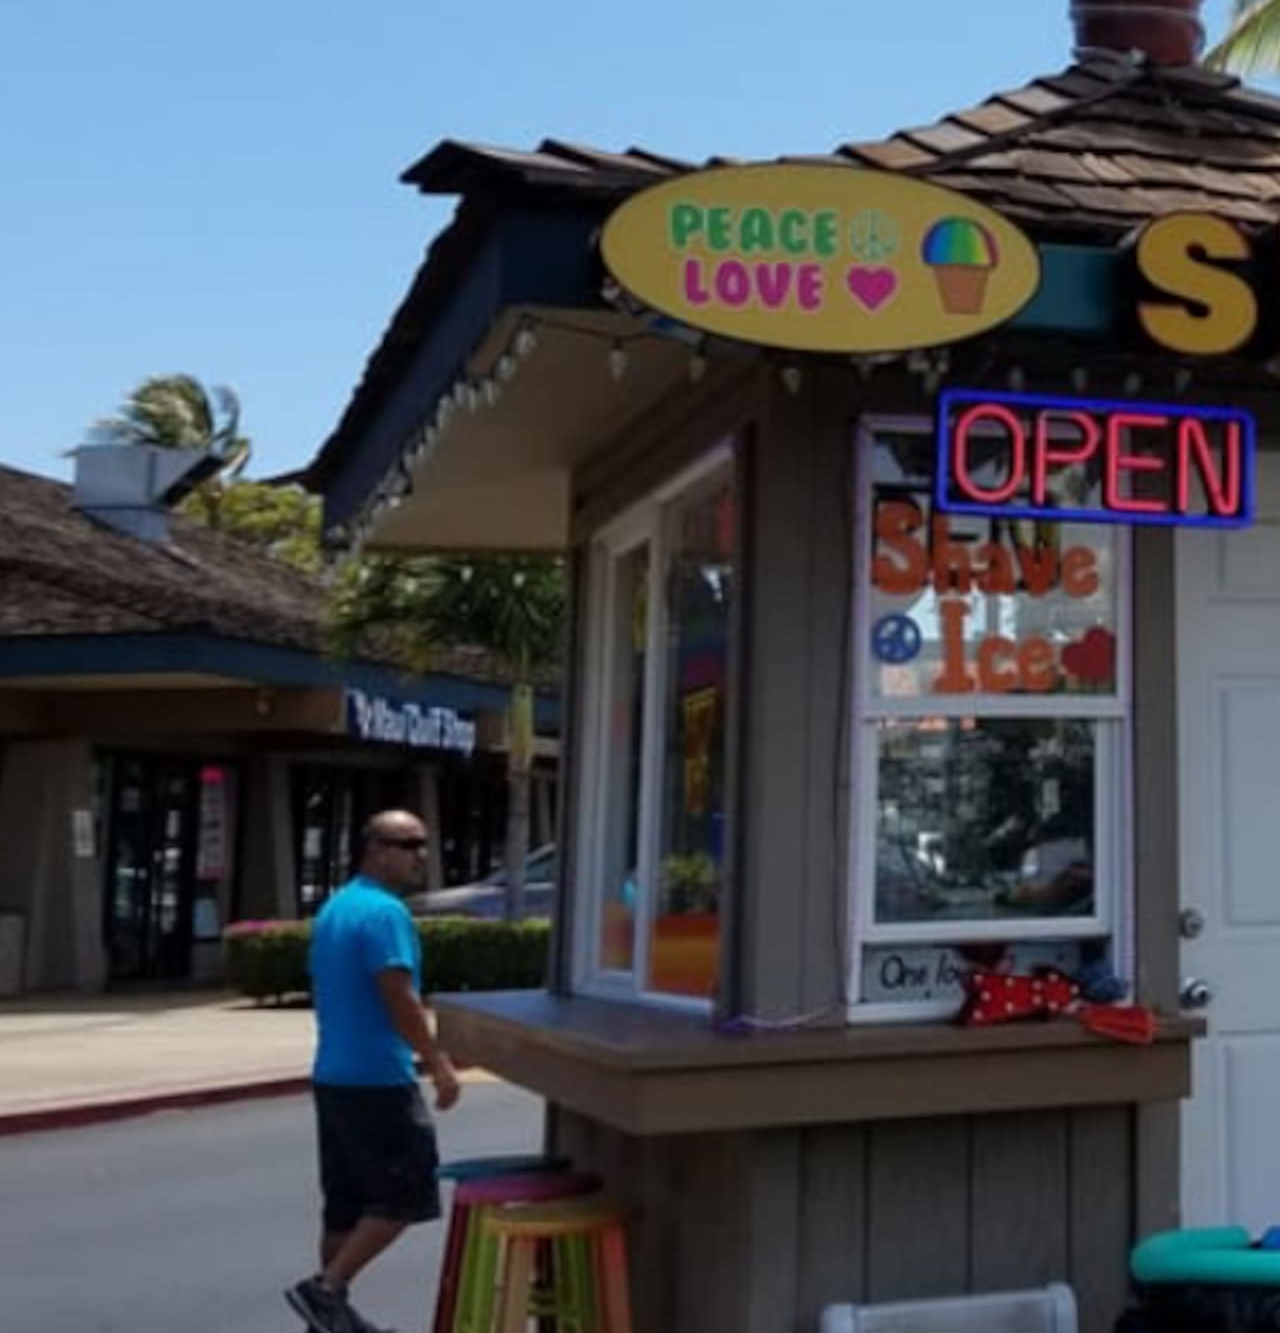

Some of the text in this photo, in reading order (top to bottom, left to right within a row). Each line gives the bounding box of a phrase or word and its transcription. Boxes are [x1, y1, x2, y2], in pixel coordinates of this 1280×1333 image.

[671, 204, 839, 257] PEACE
[685, 259, 823, 311] LOVE
[951, 401, 1243, 517] OPEN
[871, 497, 1100, 598] Shave
[931, 599, 1057, 694] Ice
[880, 954, 928, 989] One
